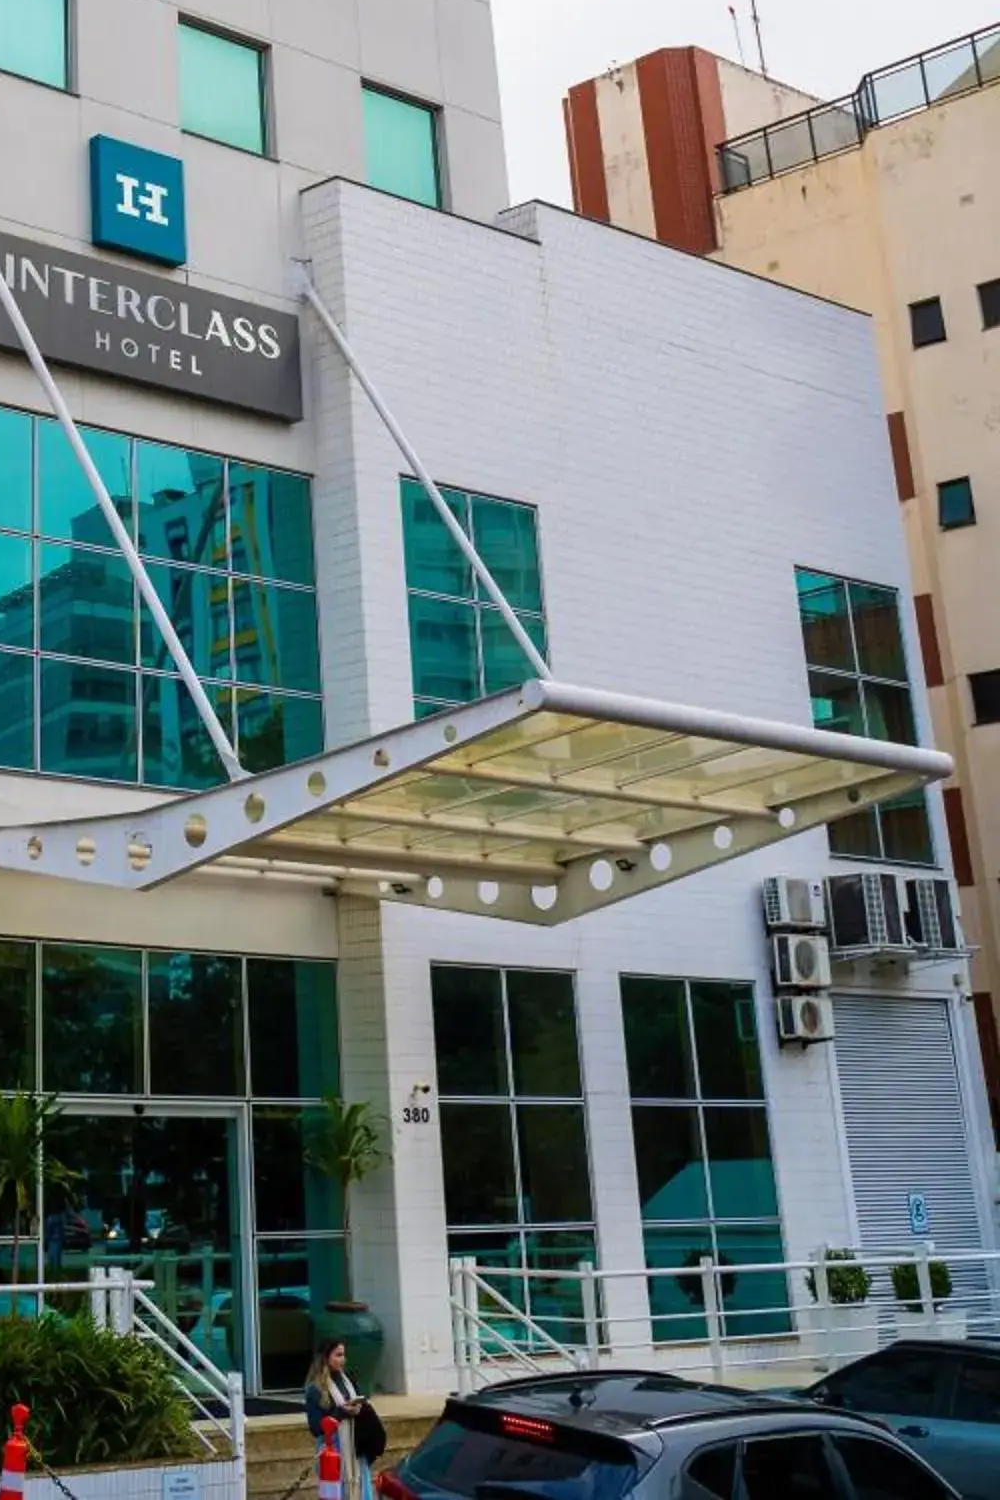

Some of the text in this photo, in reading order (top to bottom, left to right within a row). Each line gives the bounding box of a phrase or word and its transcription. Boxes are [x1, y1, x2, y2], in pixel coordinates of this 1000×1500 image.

[3, 252, 282, 360] INTERCLASS
[94, 330, 203, 376] HOTEL
[403, 1107, 430, 1123] 380
